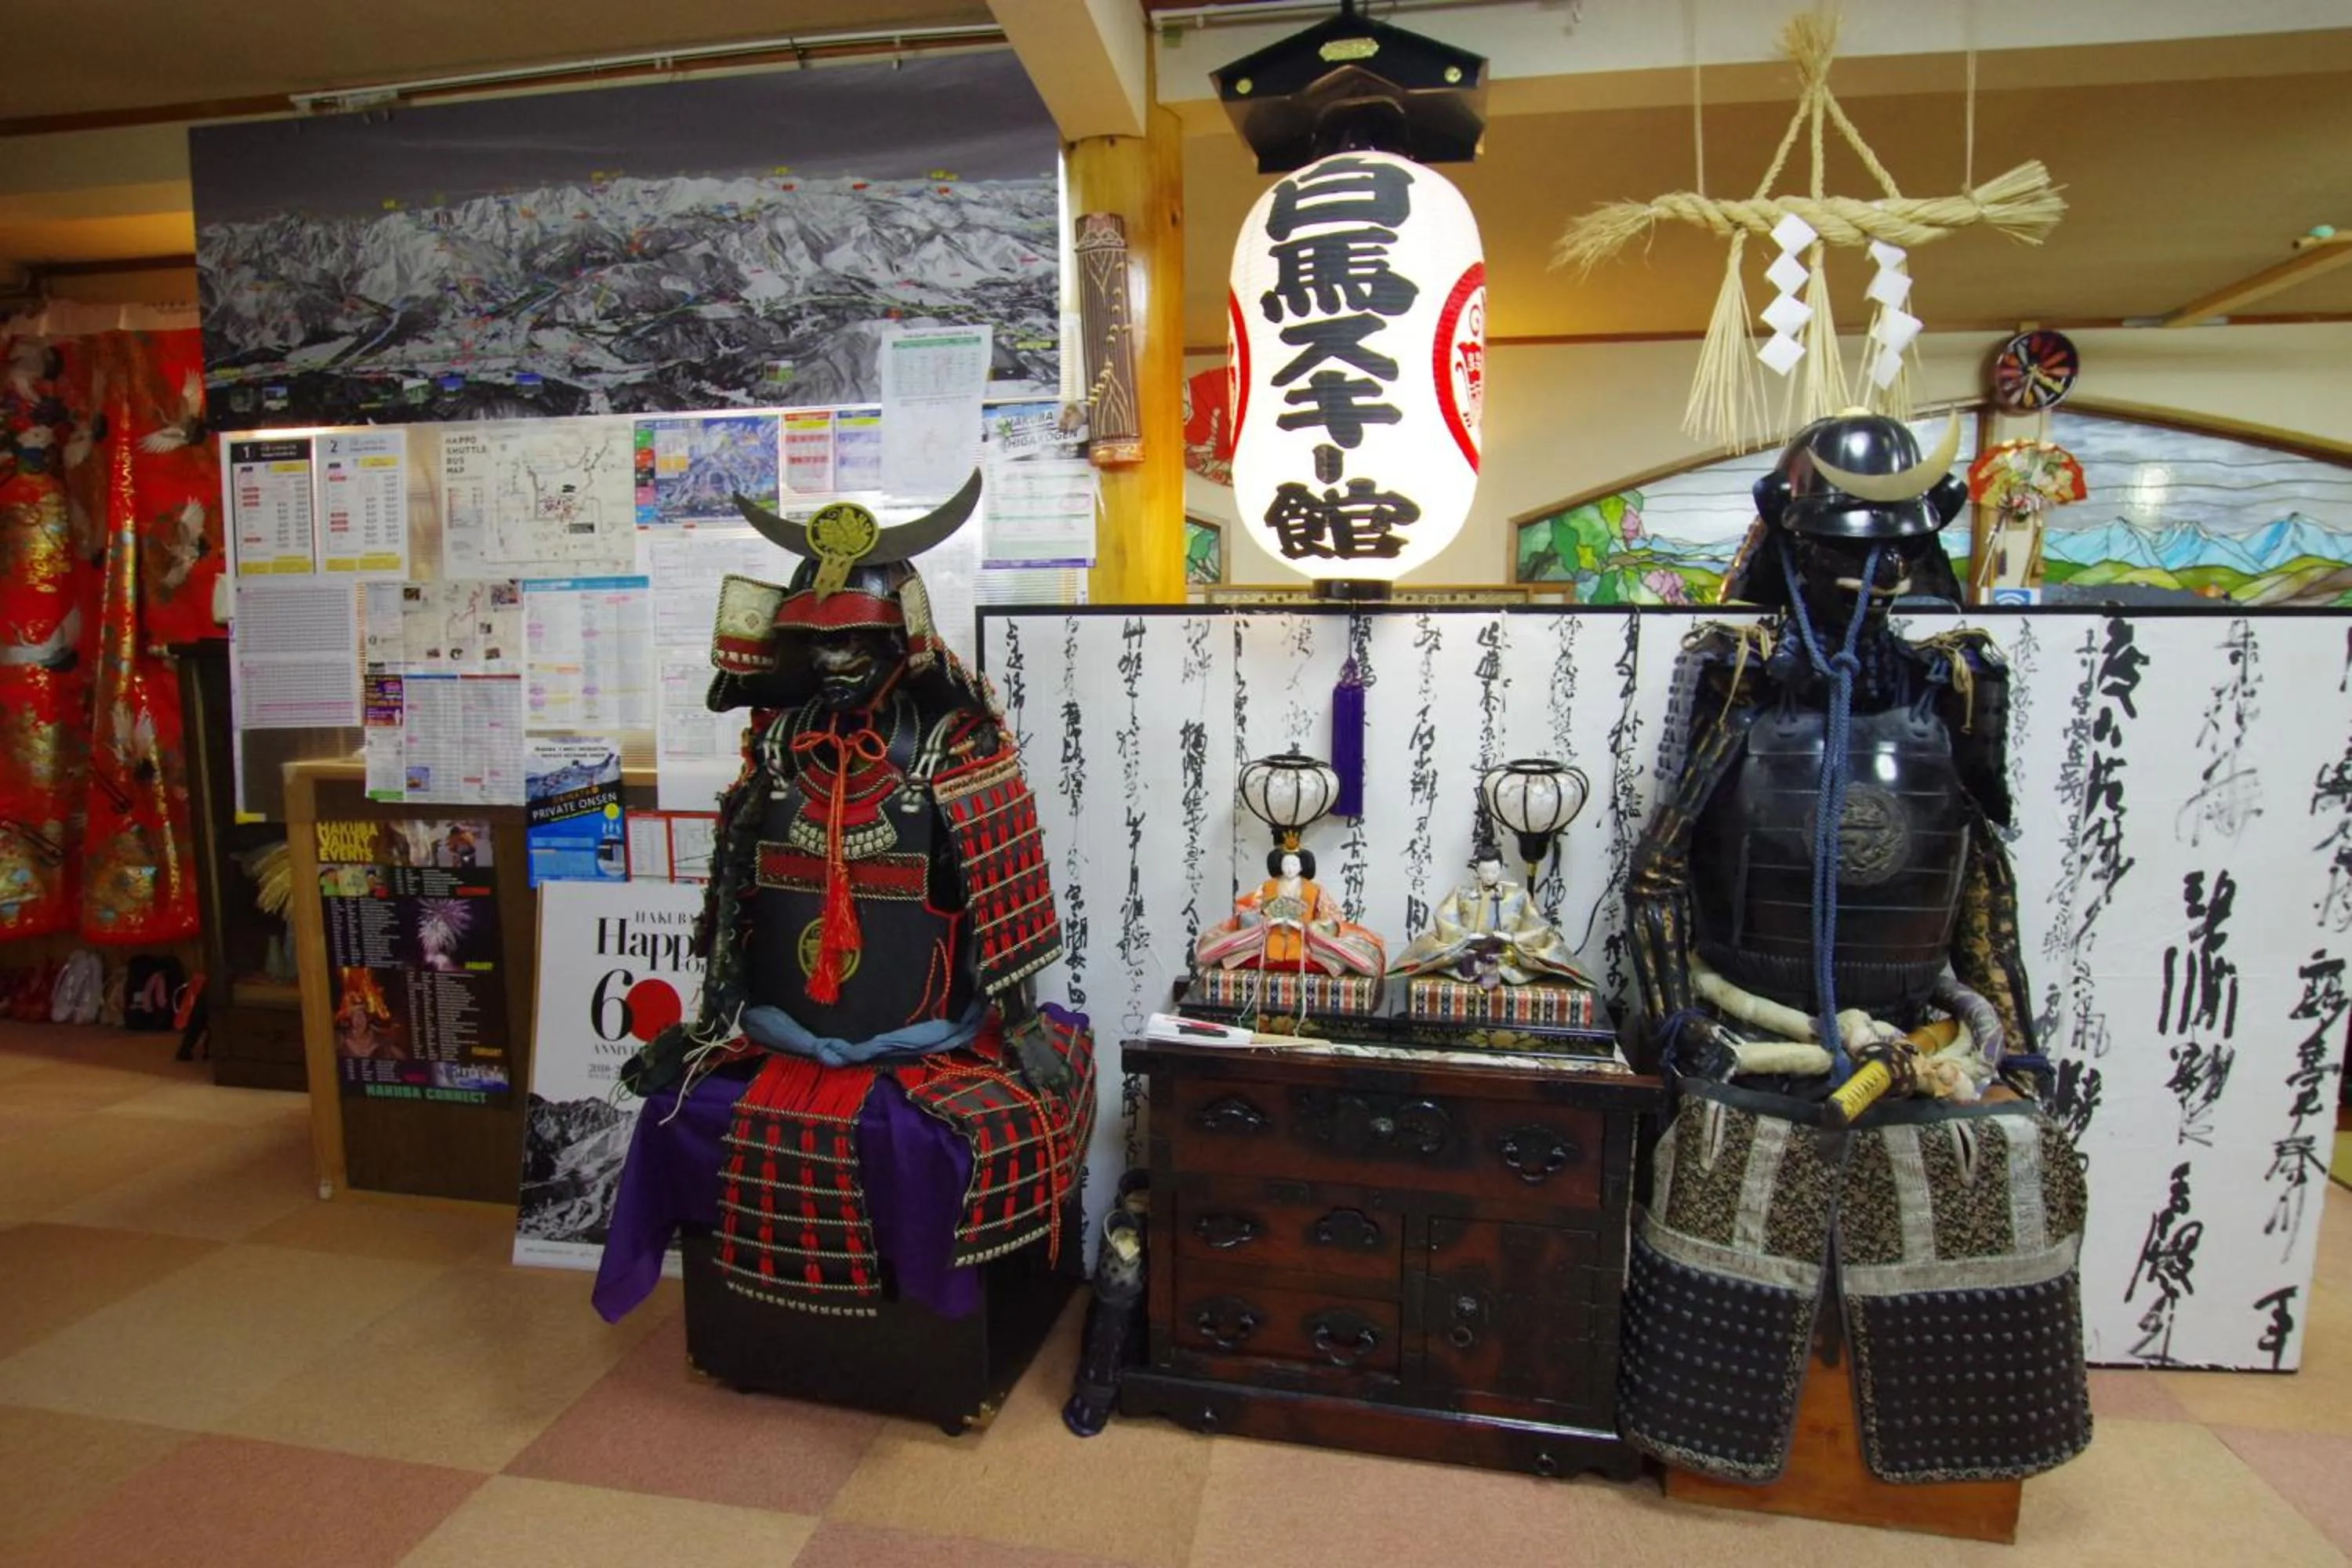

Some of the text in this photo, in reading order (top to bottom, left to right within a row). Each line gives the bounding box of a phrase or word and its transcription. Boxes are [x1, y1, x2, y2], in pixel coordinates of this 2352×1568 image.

[1260, 158, 1421, 560] 白馬スキー館
[329, 439, 338, 453] 2
[445, 436, 477, 445] HAPPO
[446, 445, 487, 455] SHUTTLE
[532, 801, 577, 821] PRIVATE
[578, 791, 618, 809] ONSEN
[317, 820, 379, 837] HAKUBA
[318, 832, 370, 848] VALLEY
[319, 846, 374, 862] EVENTS
[595, 916, 695, 972] Happ
[365, 1083, 422, 1099] HAKUBA
